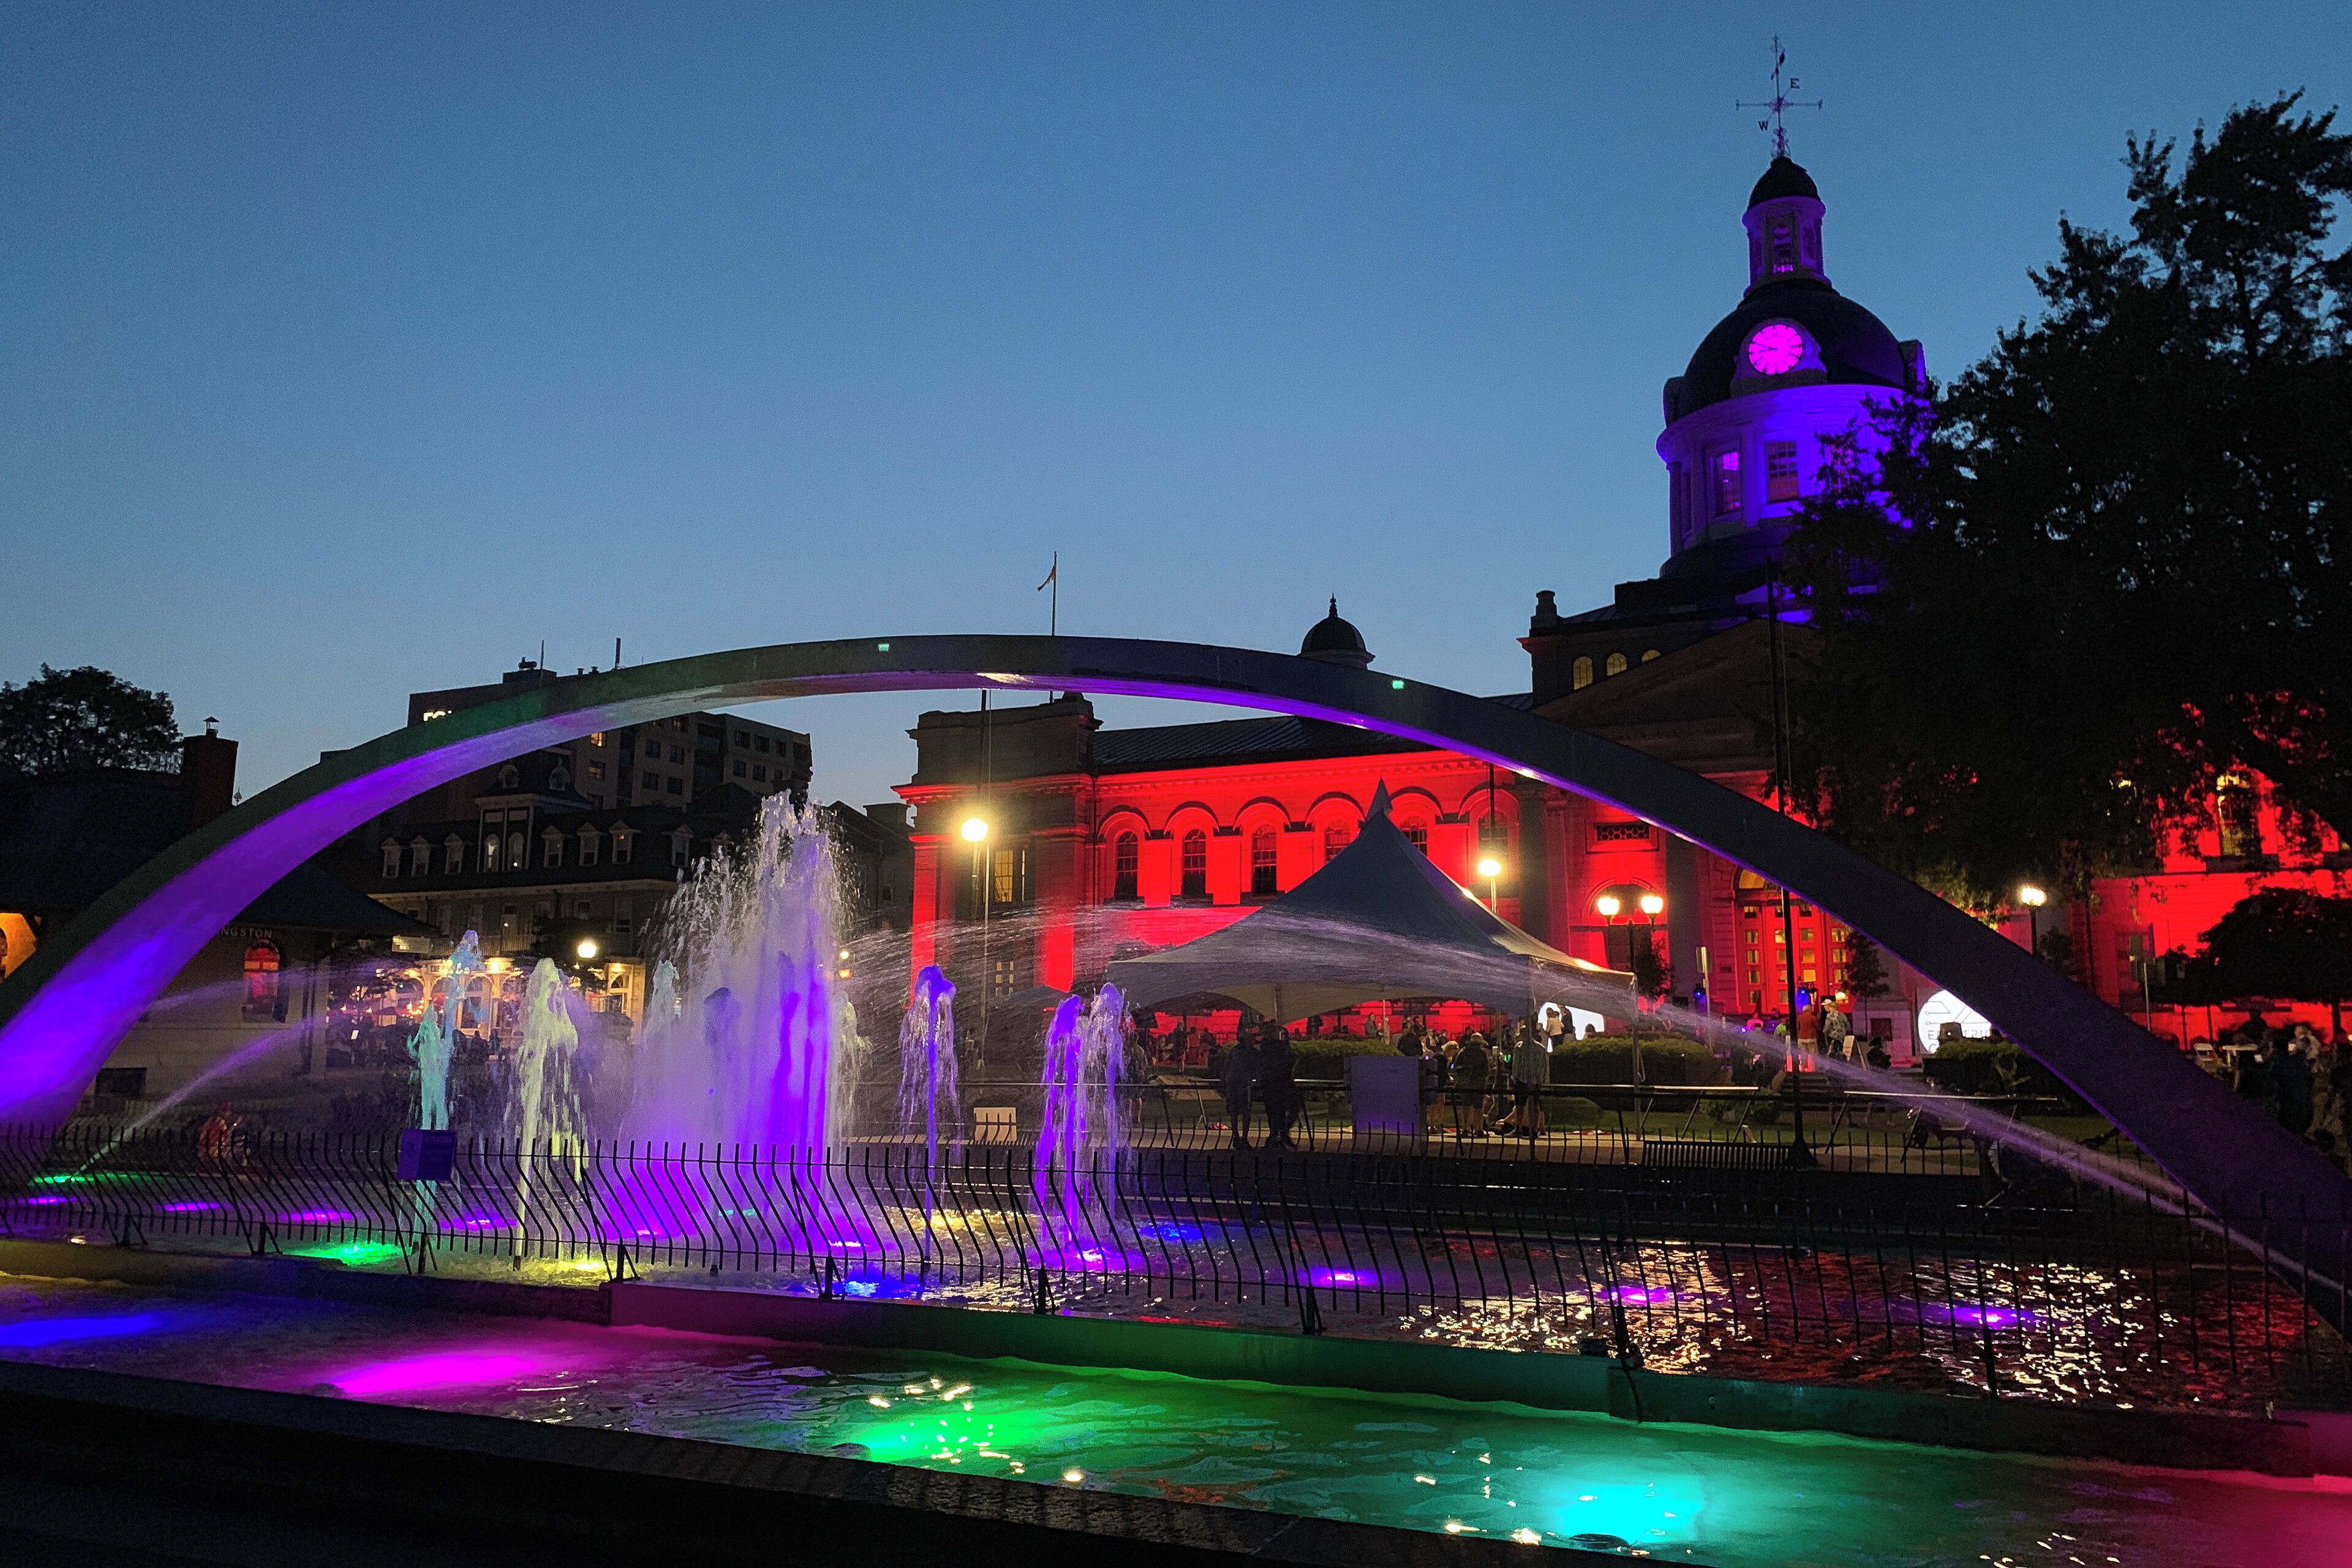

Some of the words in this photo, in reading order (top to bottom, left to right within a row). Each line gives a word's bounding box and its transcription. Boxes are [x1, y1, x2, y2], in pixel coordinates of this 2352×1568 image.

[1790, 78, 1800, 89] E
[1758, 120, 1768, 131] W
[221, 927, 273, 939] NGSTON
